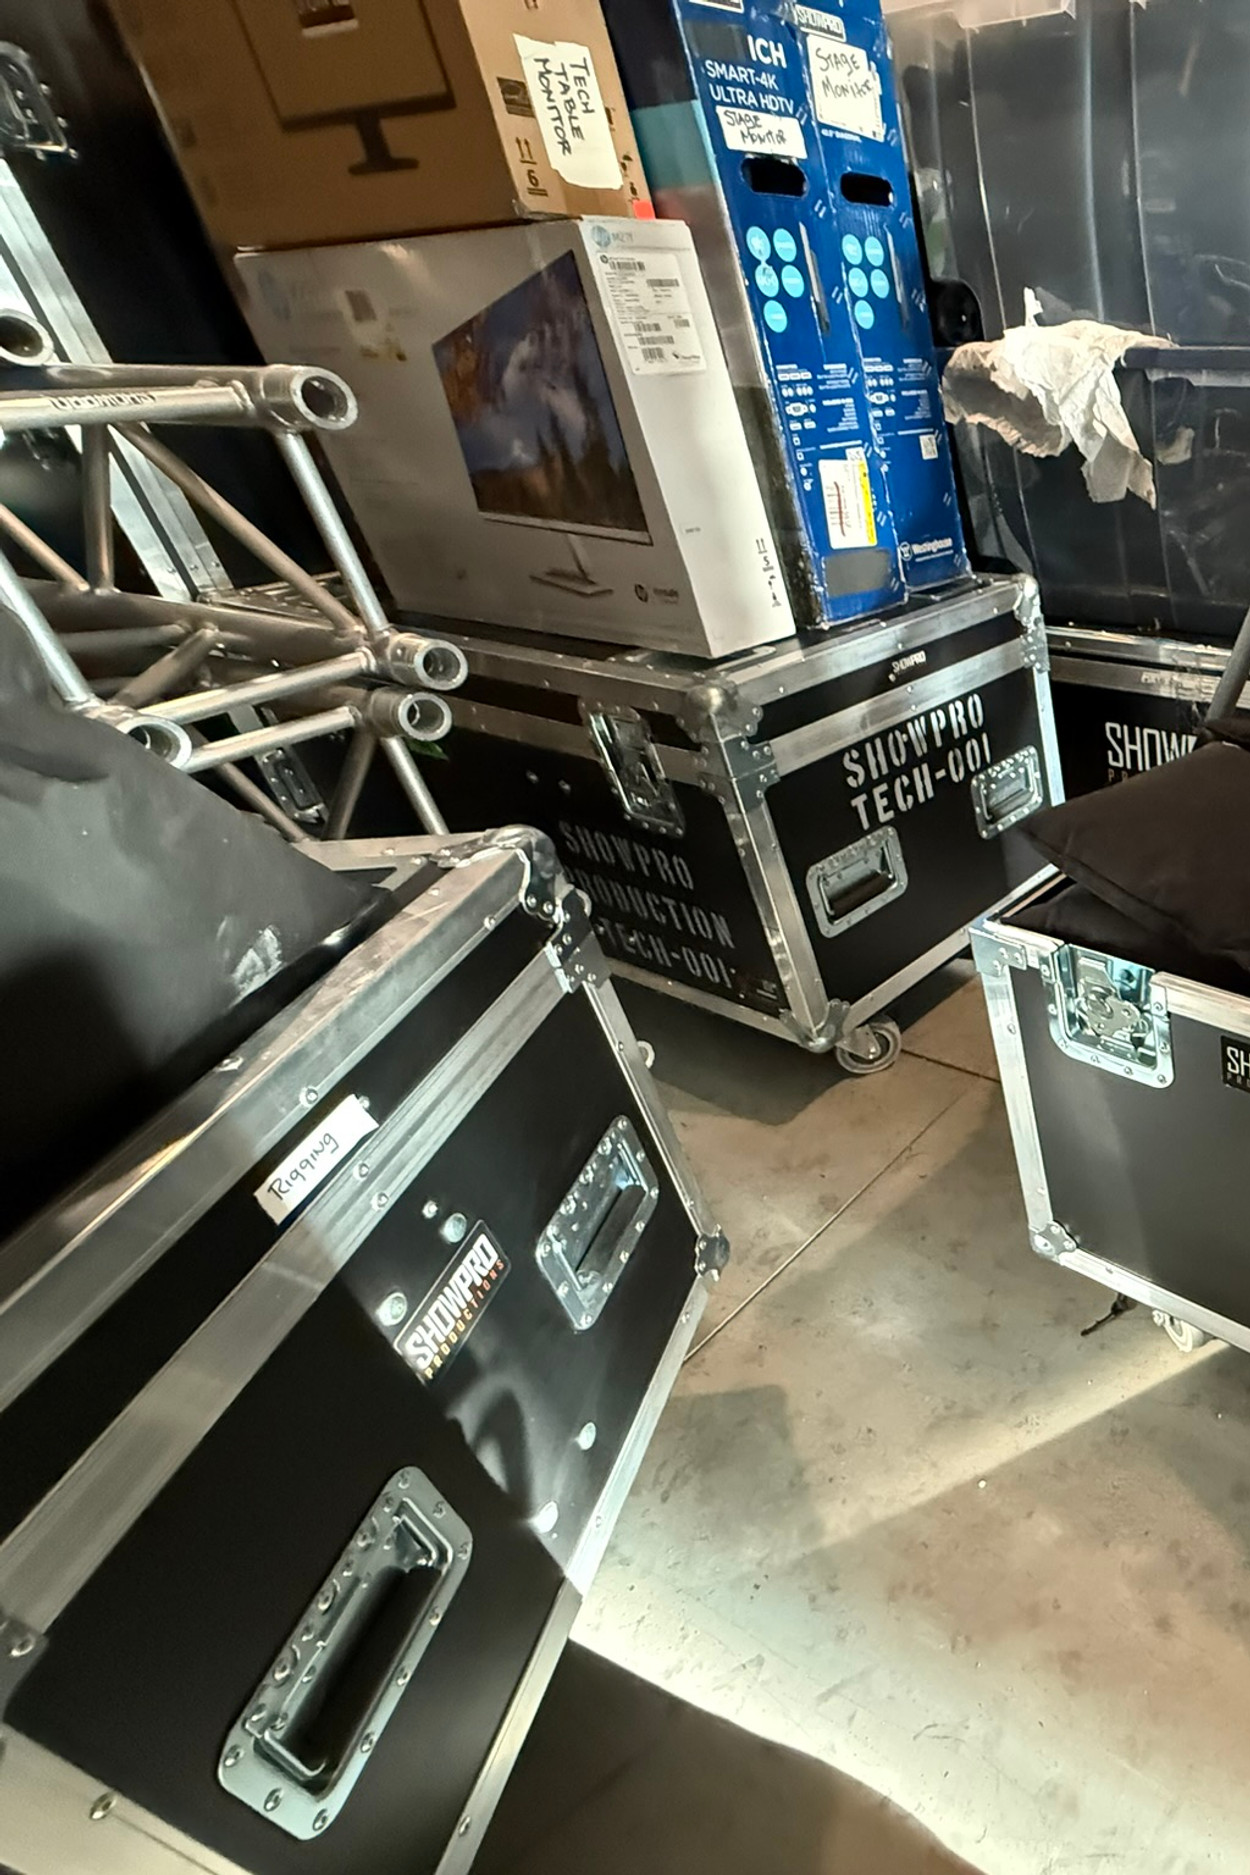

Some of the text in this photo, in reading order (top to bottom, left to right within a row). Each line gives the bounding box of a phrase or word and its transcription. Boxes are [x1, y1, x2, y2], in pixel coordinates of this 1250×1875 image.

[569, 57, 595, 114] TECH
[704, 60, 779, 91] SMART-4K
[747, 34, 787, 69] ICH
[533, 57, 572, 156] MONITOR
[555, 62, 585, 141] TABLE
[709, 83, 794, 115] ULTRA HDTV
[842, 693, 984, 789] SHOWPRO
[1105, 721, 1198, 771] SHOW
[850, 732, 991, 831] TECH-001
[559, 820, 694, 890] SHOWPRO
[404, 1233, 499, 1370] SHOWPRO
[424, 1259, 504, 1379] PRODUCTIONS
